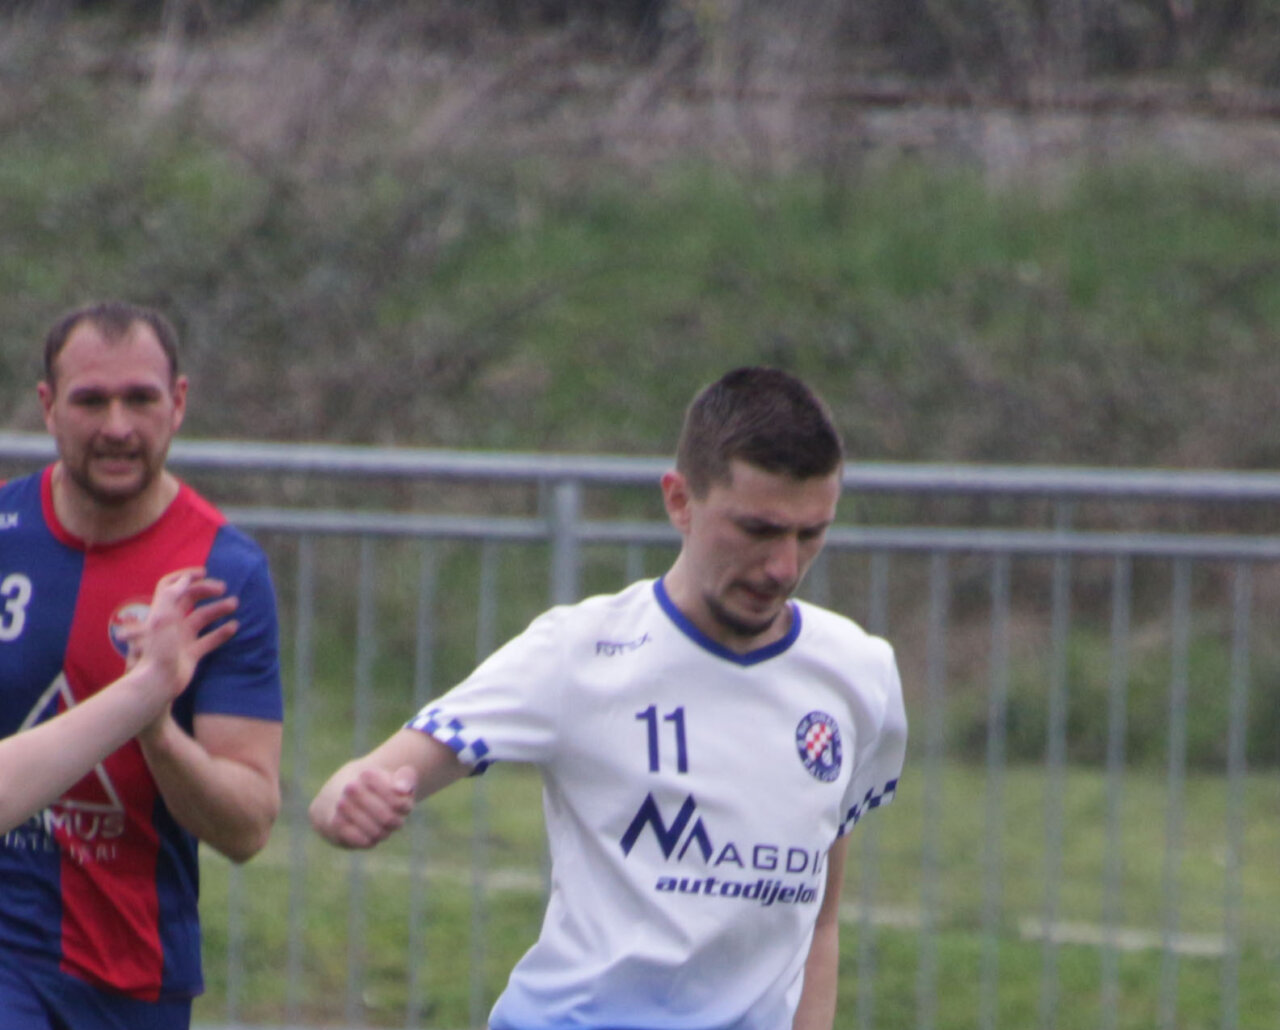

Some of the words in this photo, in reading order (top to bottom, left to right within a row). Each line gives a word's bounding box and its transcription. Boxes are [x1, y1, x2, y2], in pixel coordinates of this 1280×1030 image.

[635, 705, 688, 774] 11
[620, 791, 827, 876] MAGDI
[655, 876, 817, 906] autodijelo
